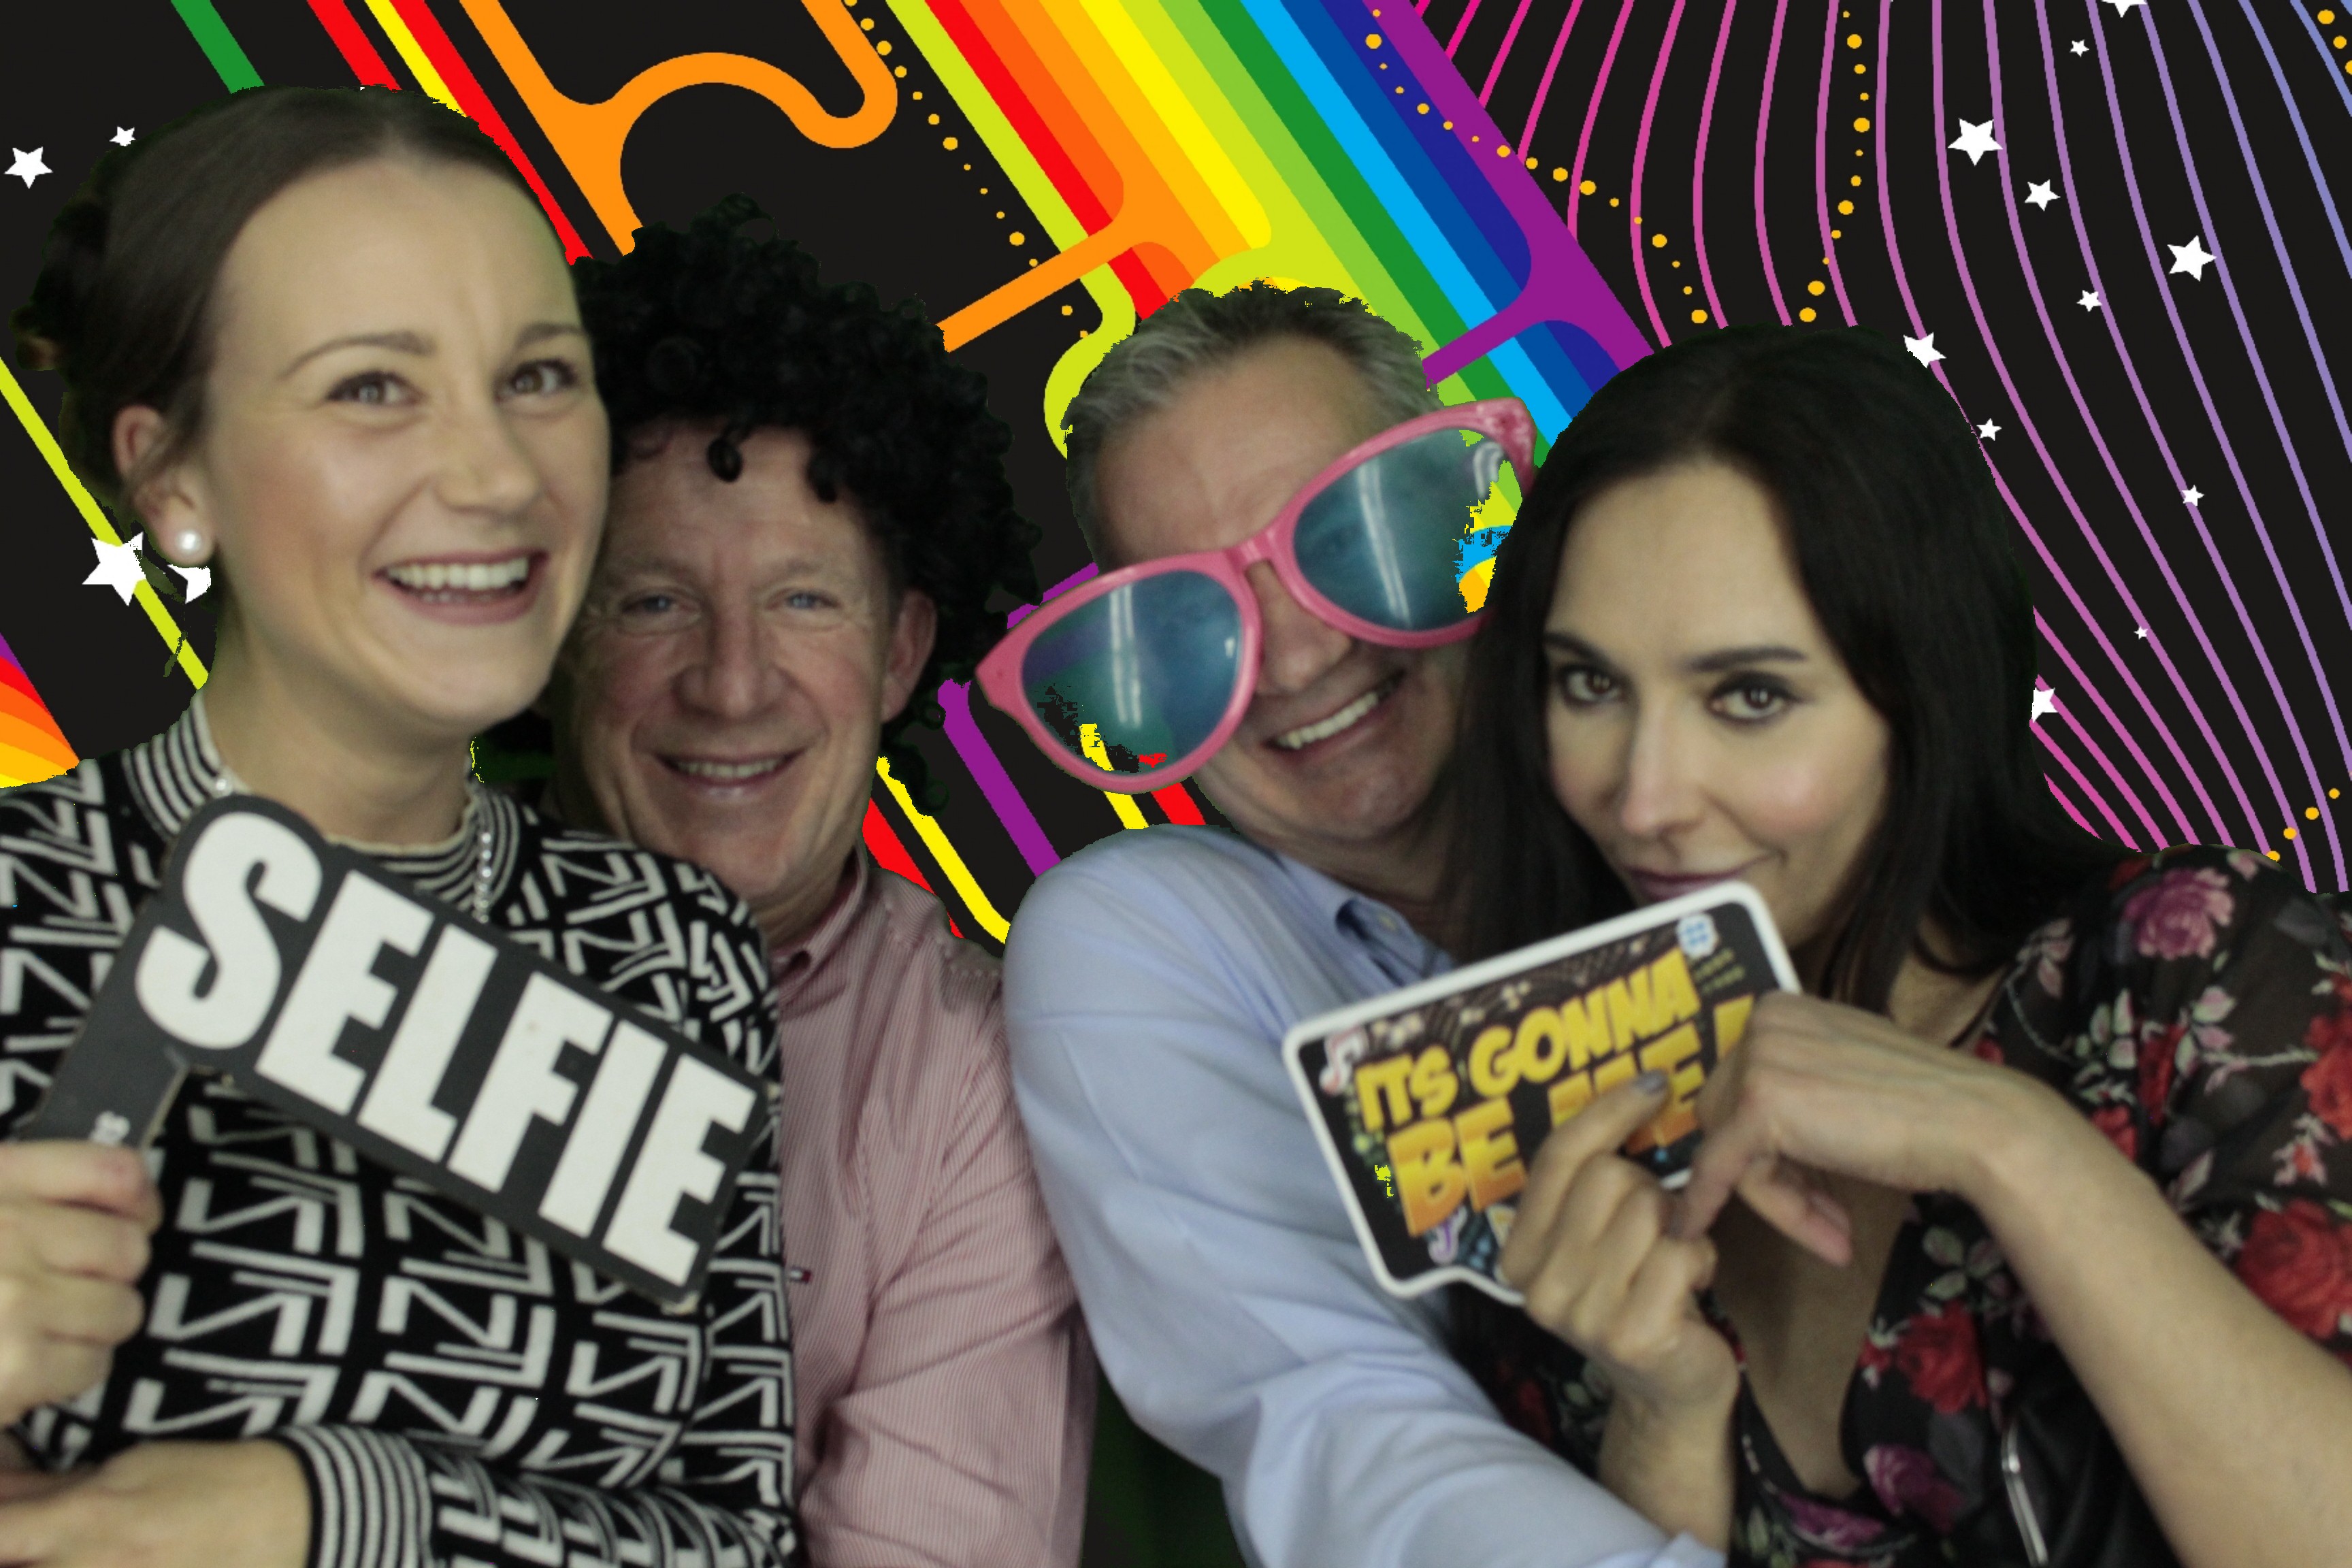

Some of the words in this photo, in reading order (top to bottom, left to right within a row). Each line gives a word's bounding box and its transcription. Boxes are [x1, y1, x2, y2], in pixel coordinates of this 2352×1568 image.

[137, 812, 758, 1288] SELFIE
[1468, 947, 1701, 1097] GONNA
[1387, 1097, 1529, 1238] BE
